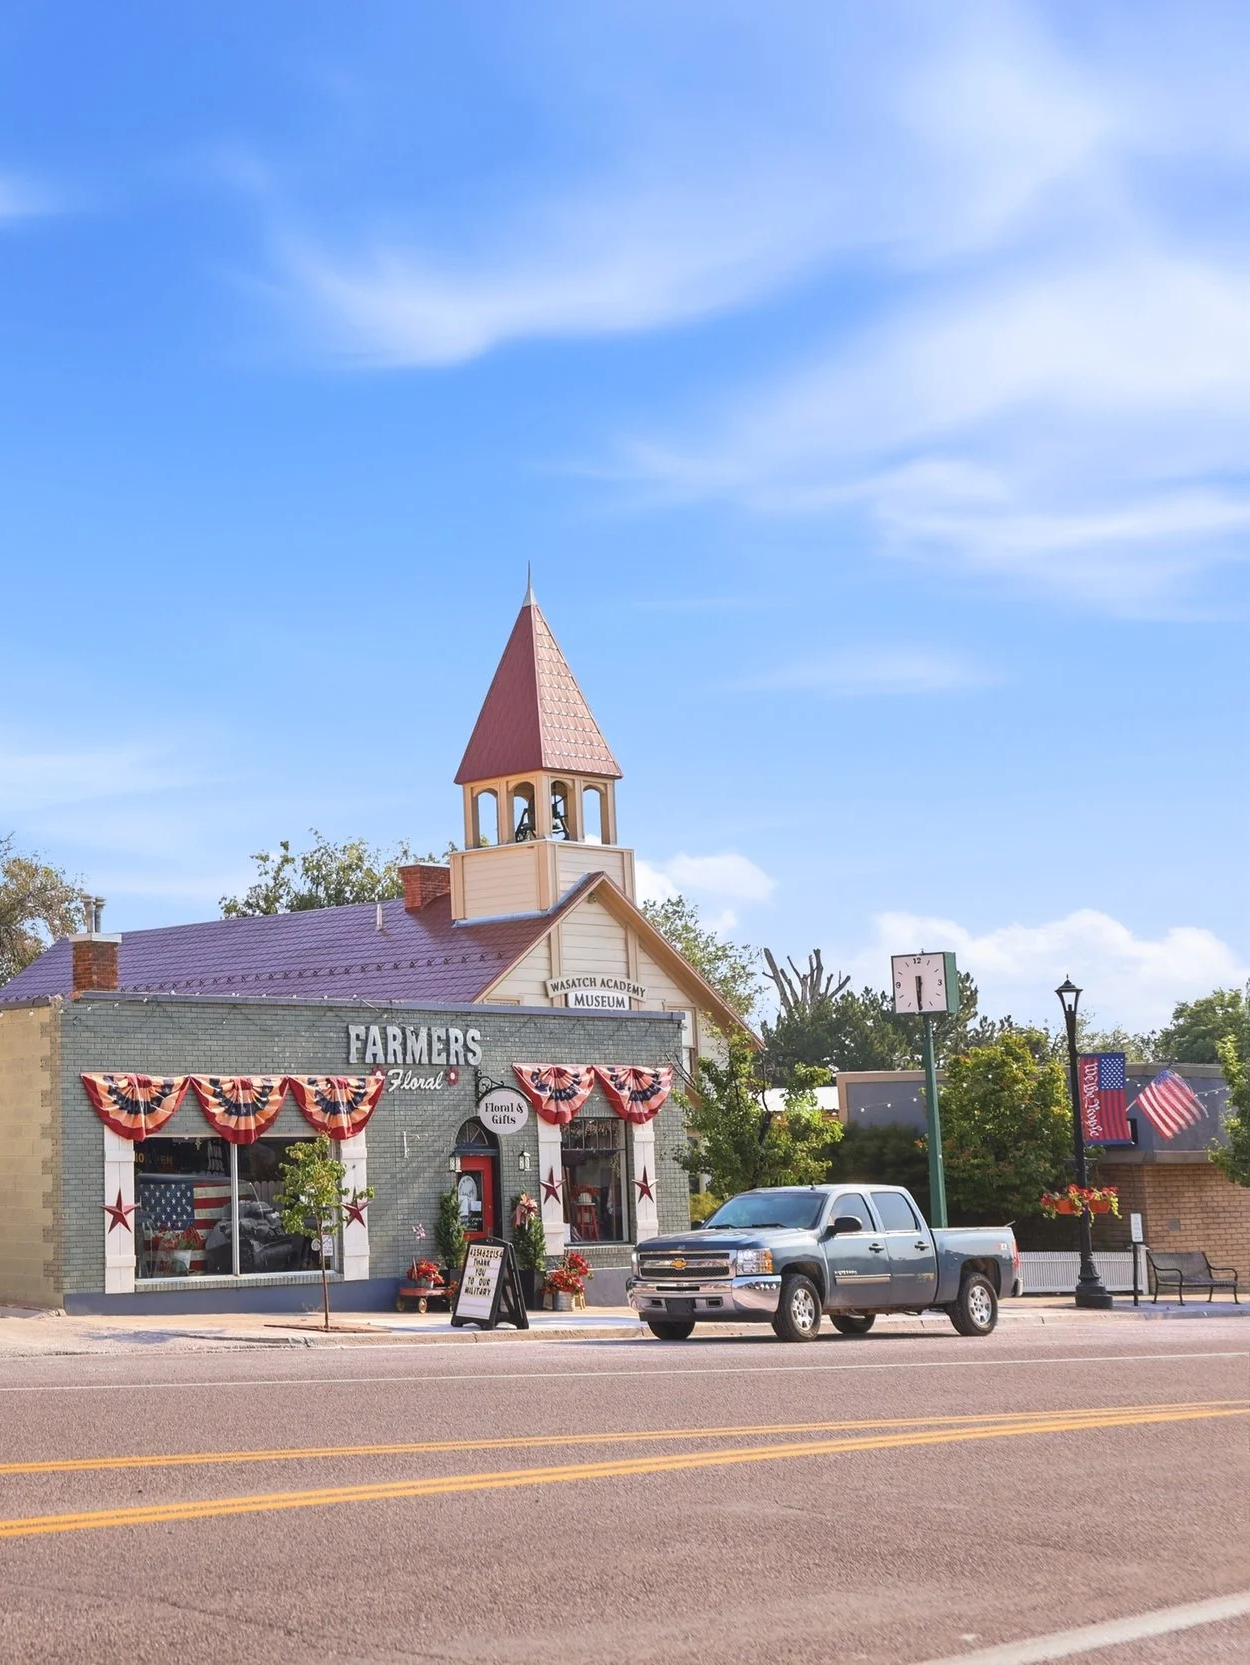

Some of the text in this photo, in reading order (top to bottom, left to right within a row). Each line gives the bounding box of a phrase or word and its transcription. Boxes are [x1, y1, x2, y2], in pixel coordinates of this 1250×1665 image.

[550, 977, 646, 998] WASATCH ACADEMY
[895, 981, 901, 989] 9
[574, 993, 626, 1008] MUSEUM
[348, 1025, 483, 1066] FARMERS
[1084, 1062, 1098, 1083] We
[387, 1069, 444, 1093] Floral
[484, 1102, 524, 1114] Floral &
[492, 1113, 516, 1125] Gifts
[1085, 1098, 1103, 1137] People
[474, 1258, 490, 1267] THANK
[475, 1268, 486, 1276] YOU
[468, 1276, 490, 1286] TO OUR
[465, 1286, 491, 1296] MILITARY
